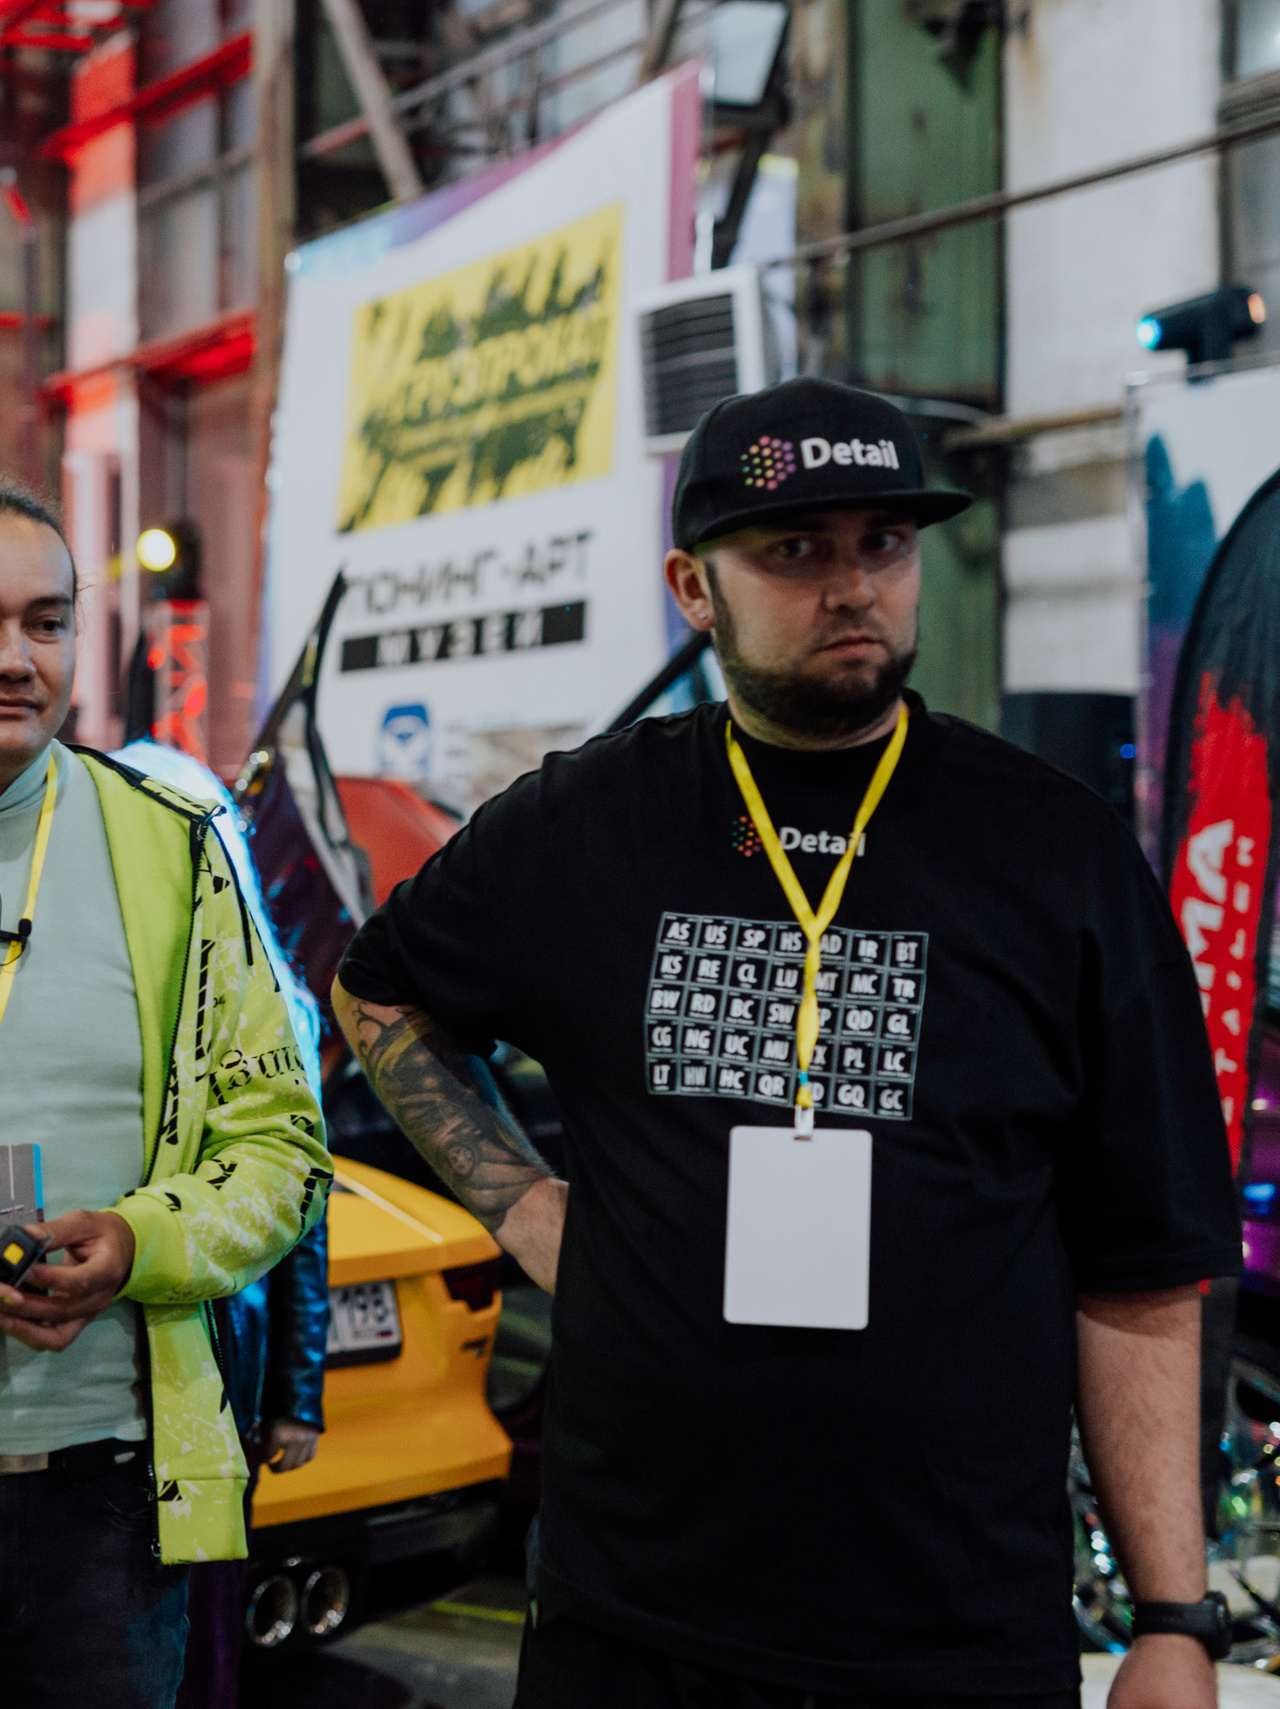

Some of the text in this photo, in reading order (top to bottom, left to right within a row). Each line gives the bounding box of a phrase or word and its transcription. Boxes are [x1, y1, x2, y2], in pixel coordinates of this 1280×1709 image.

[800, 437, 900, 470] Detail
[666, 921, 918, 962] AS US SP HS AD IR BT
[1181, 819, 1234, 1019] MA
[697, 959, 721, 978] RE
[737, 963, 757, 983] CL
[775, 968, 798, 988] LU
[851, 973, 878, 994] MC
[893, 978, 916, 998] TR
[651, 989, 680, 1009] BW
[690, 993, 716, 1013] RD
[730, 998, 755, 1019] BC
[768, 1002, 795, 1024] SW
[846, 1009, 874, 1030] QD
[887, 1013, 910, 1034] GL
[652, 1026, 672, 1047] CG
[685, 1028, 711, 1049] NG
[725, 1033, 750, 1055] UC
[763, 1039, 789, 1060] MU
[843, 1047, 865, 1068] PL
[883, 1050, 906, 1071] LC
[653, 1064, 671, 1085] LT
[719, 1068, 745, 1089] HC
[758, 1074, 785, 1097] QR
[837, 1084, 865, 1108] GQ
[880, 1088, 904, 1110] GC
